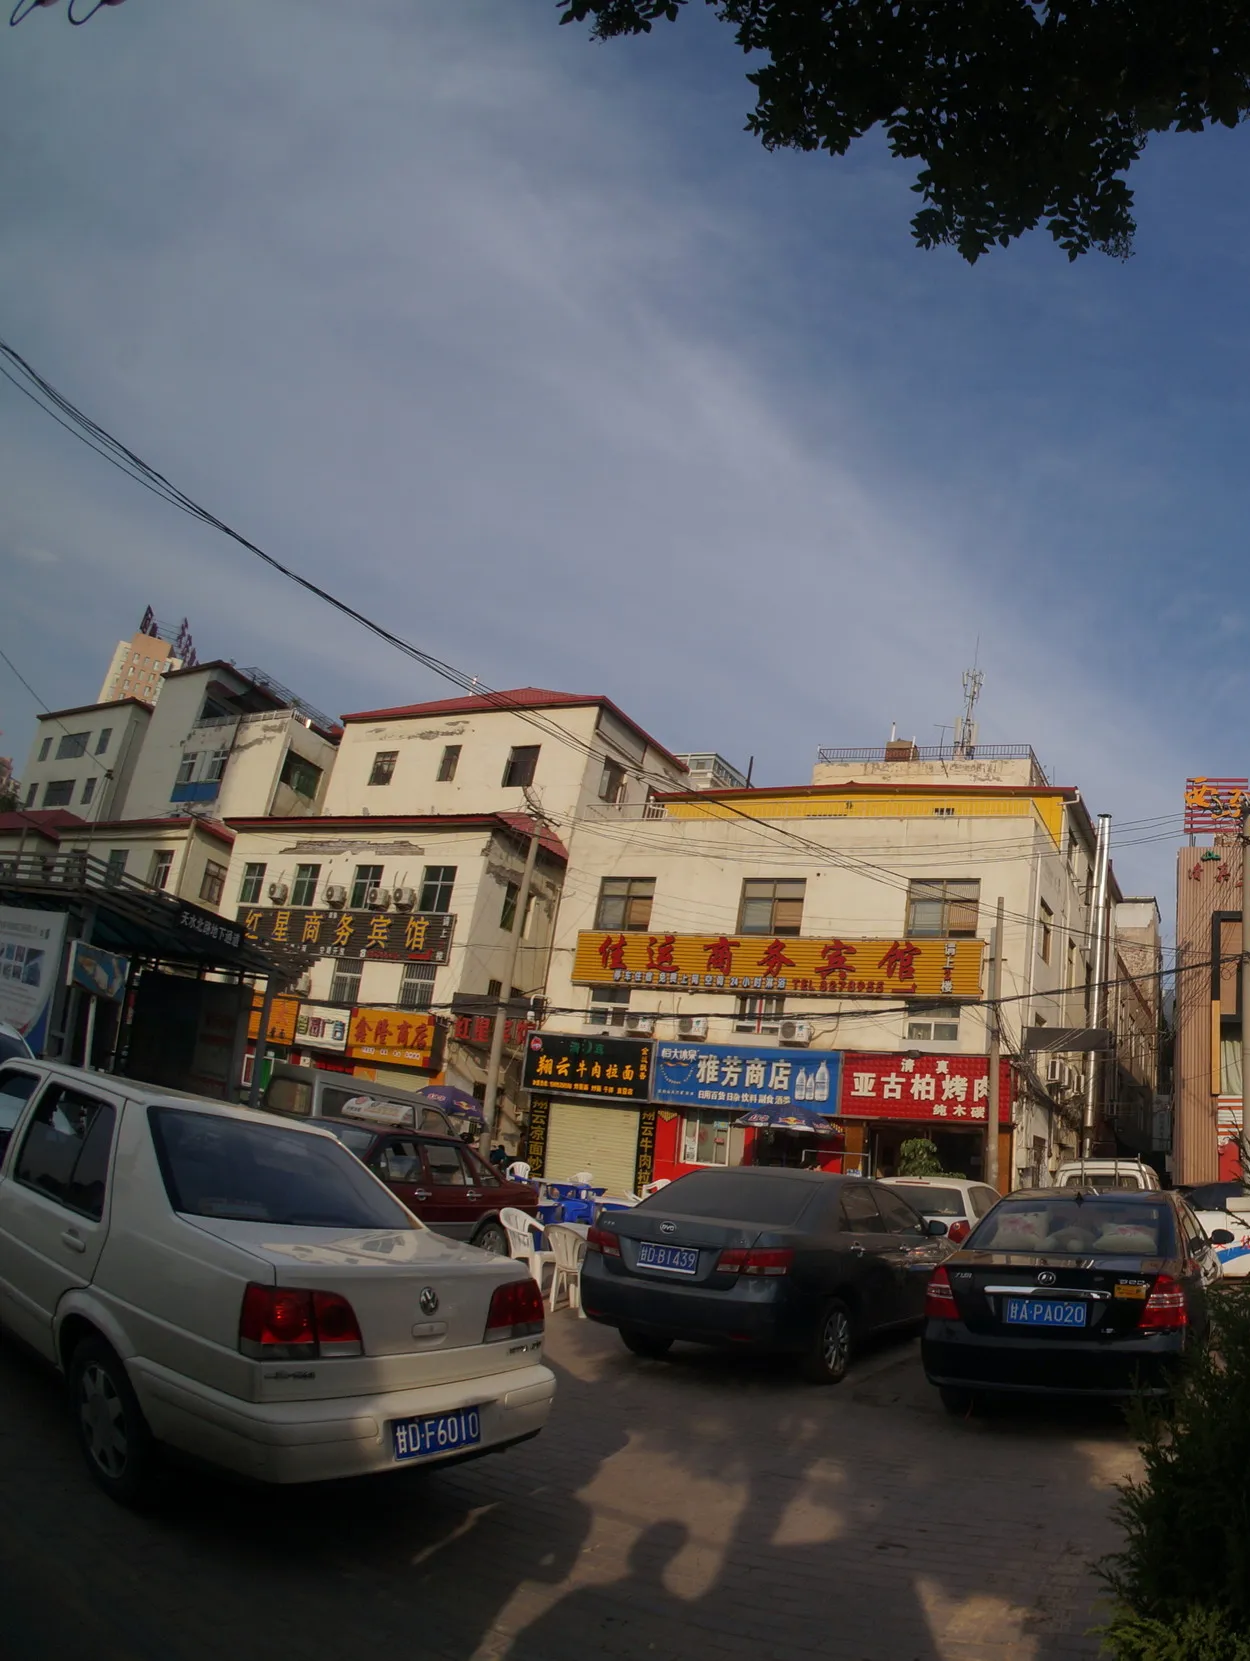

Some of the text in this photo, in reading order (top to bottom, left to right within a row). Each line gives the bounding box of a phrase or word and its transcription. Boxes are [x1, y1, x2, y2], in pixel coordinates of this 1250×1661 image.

[244, 909, 430, 950] 红星商务宾馆
[598, 933, 922, 981] 佳运商务宾馆
[792, 979, 815, 991] TEL
[536, 1055, 635, 1081] 翔云牛肉拉面
[696, 1054, 792, 1091] 雅芳商店
[901, 1058, 949, 1075] 清真
[697, 1090, 726, 1101] 日用百货
[741, 1093, 758, 1104] 饮料
[758, 1094, 774, 1105] 副食
[850, 1072, 990, 1102] 亚古柏烤肉
[932, 1104, 985, 1119] 纯木碳
